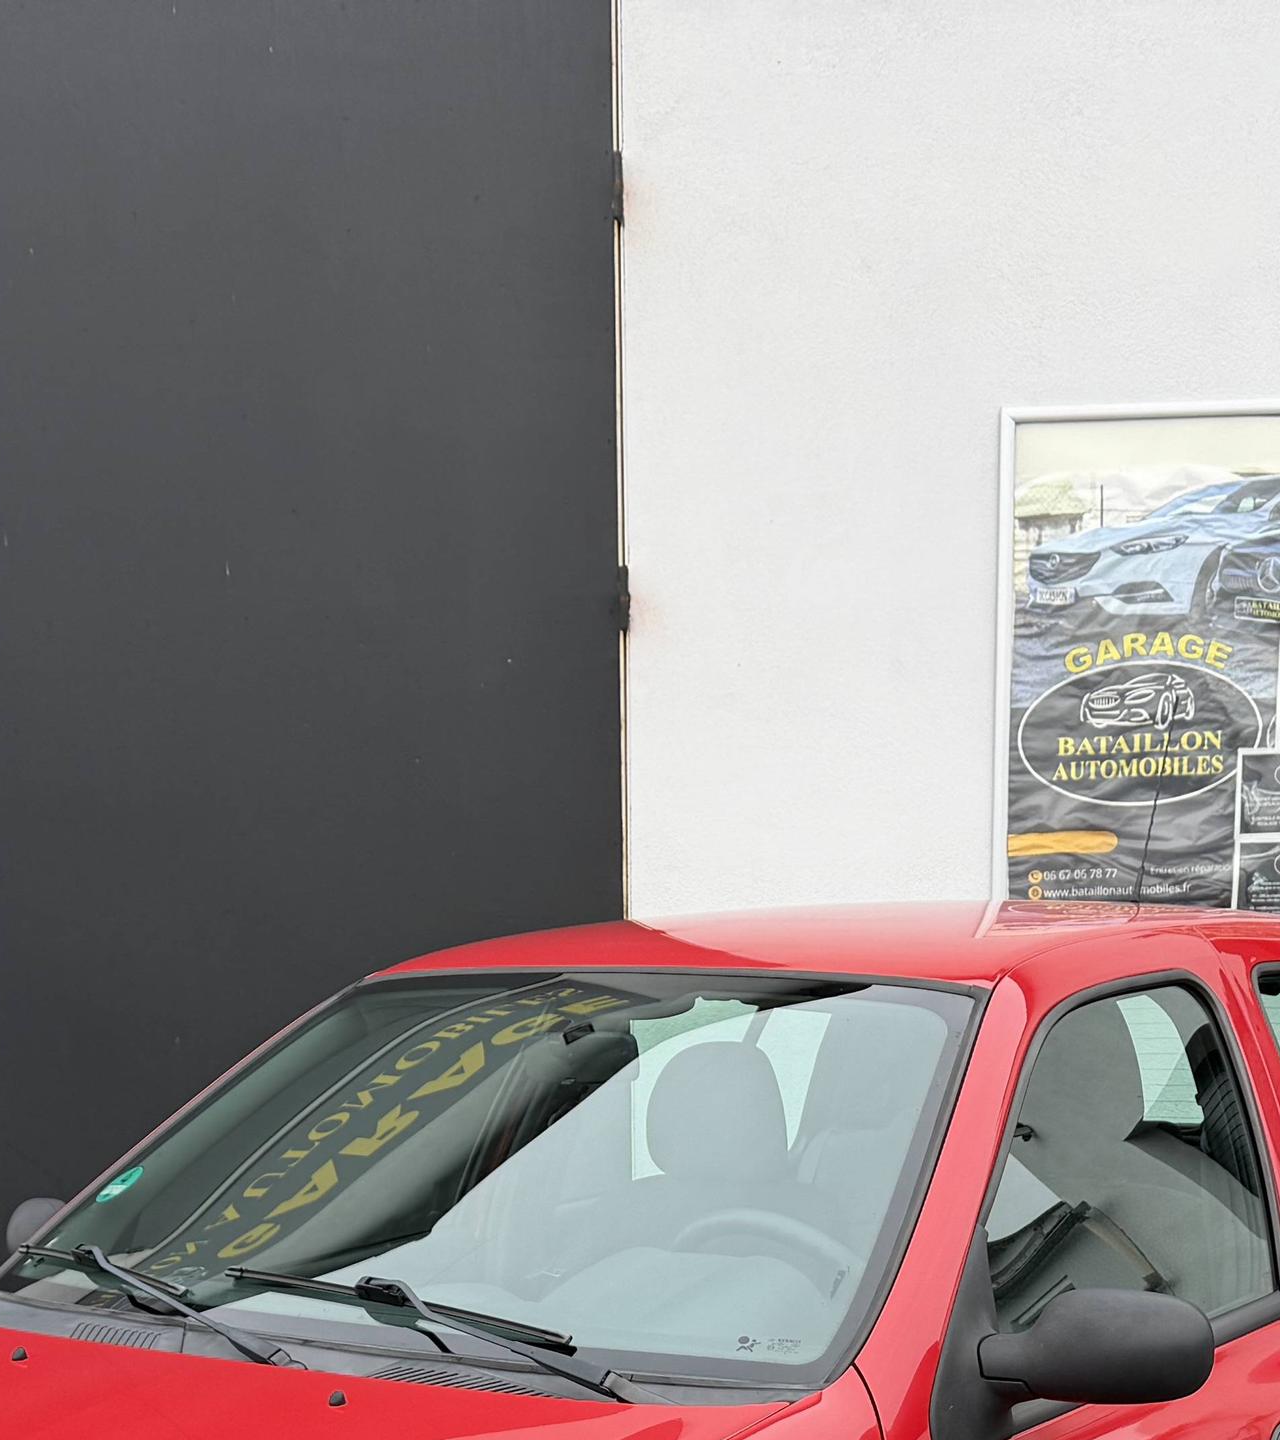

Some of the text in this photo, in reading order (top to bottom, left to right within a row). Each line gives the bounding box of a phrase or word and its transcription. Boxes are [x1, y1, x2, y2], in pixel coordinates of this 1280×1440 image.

[1064, 632, 1234, 674] GARAGE
[1057, 729, 1222, 756] BATAILLON
[1052, 754, 1224, 782] AUTOMOBILES
[1043, 868, 1117, 881] 06 67 06 78 77
[1043, 883, 1191, 898] www.bataillonautmobiles.fr
